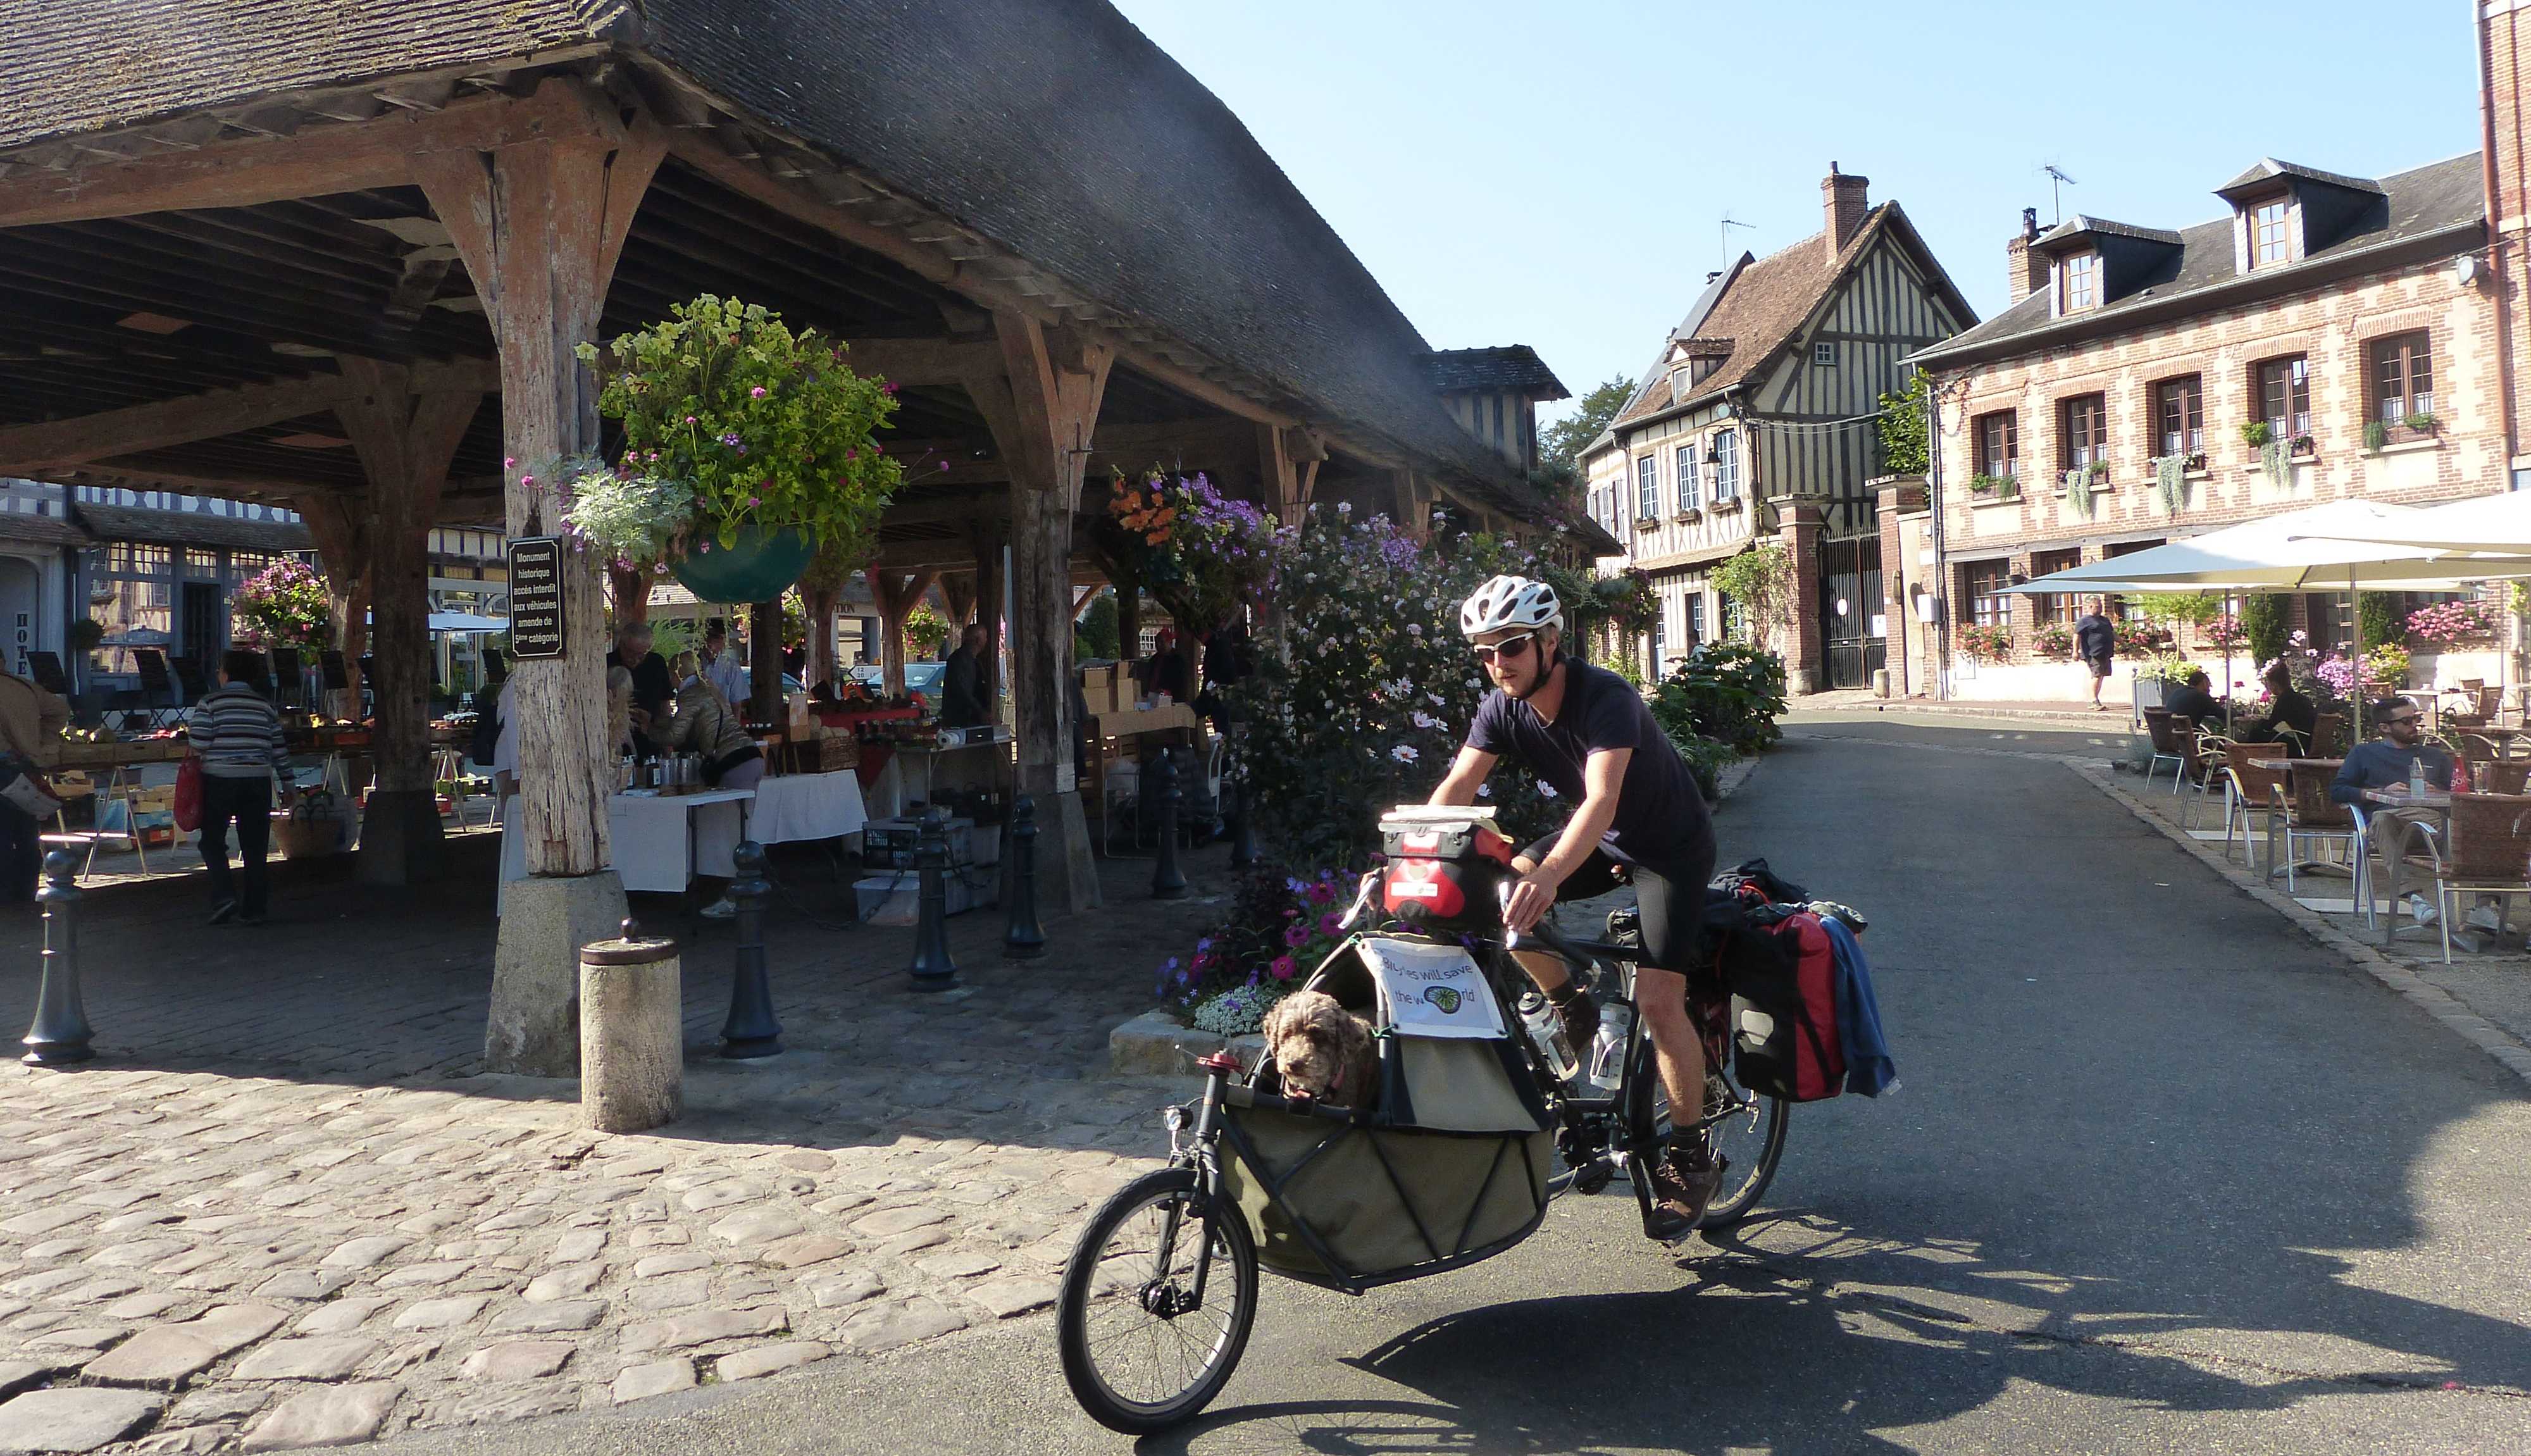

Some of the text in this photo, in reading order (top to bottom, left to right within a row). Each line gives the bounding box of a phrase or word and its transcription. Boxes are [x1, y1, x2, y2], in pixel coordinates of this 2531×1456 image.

[517, 552, 550, 563] Monument
[518, 568, 550, 580] historique
[533, 583, 556, 594] interdit
[514, 600, 557, 612] aux véhicules
[518, 616, 552, 627] amende de
[529, 632, 558, 645] catégorie
[1420, 968, 1444, 981] will
[1445, 965, 1473, 979] save
[1395, 988, 1412, 1004] the
